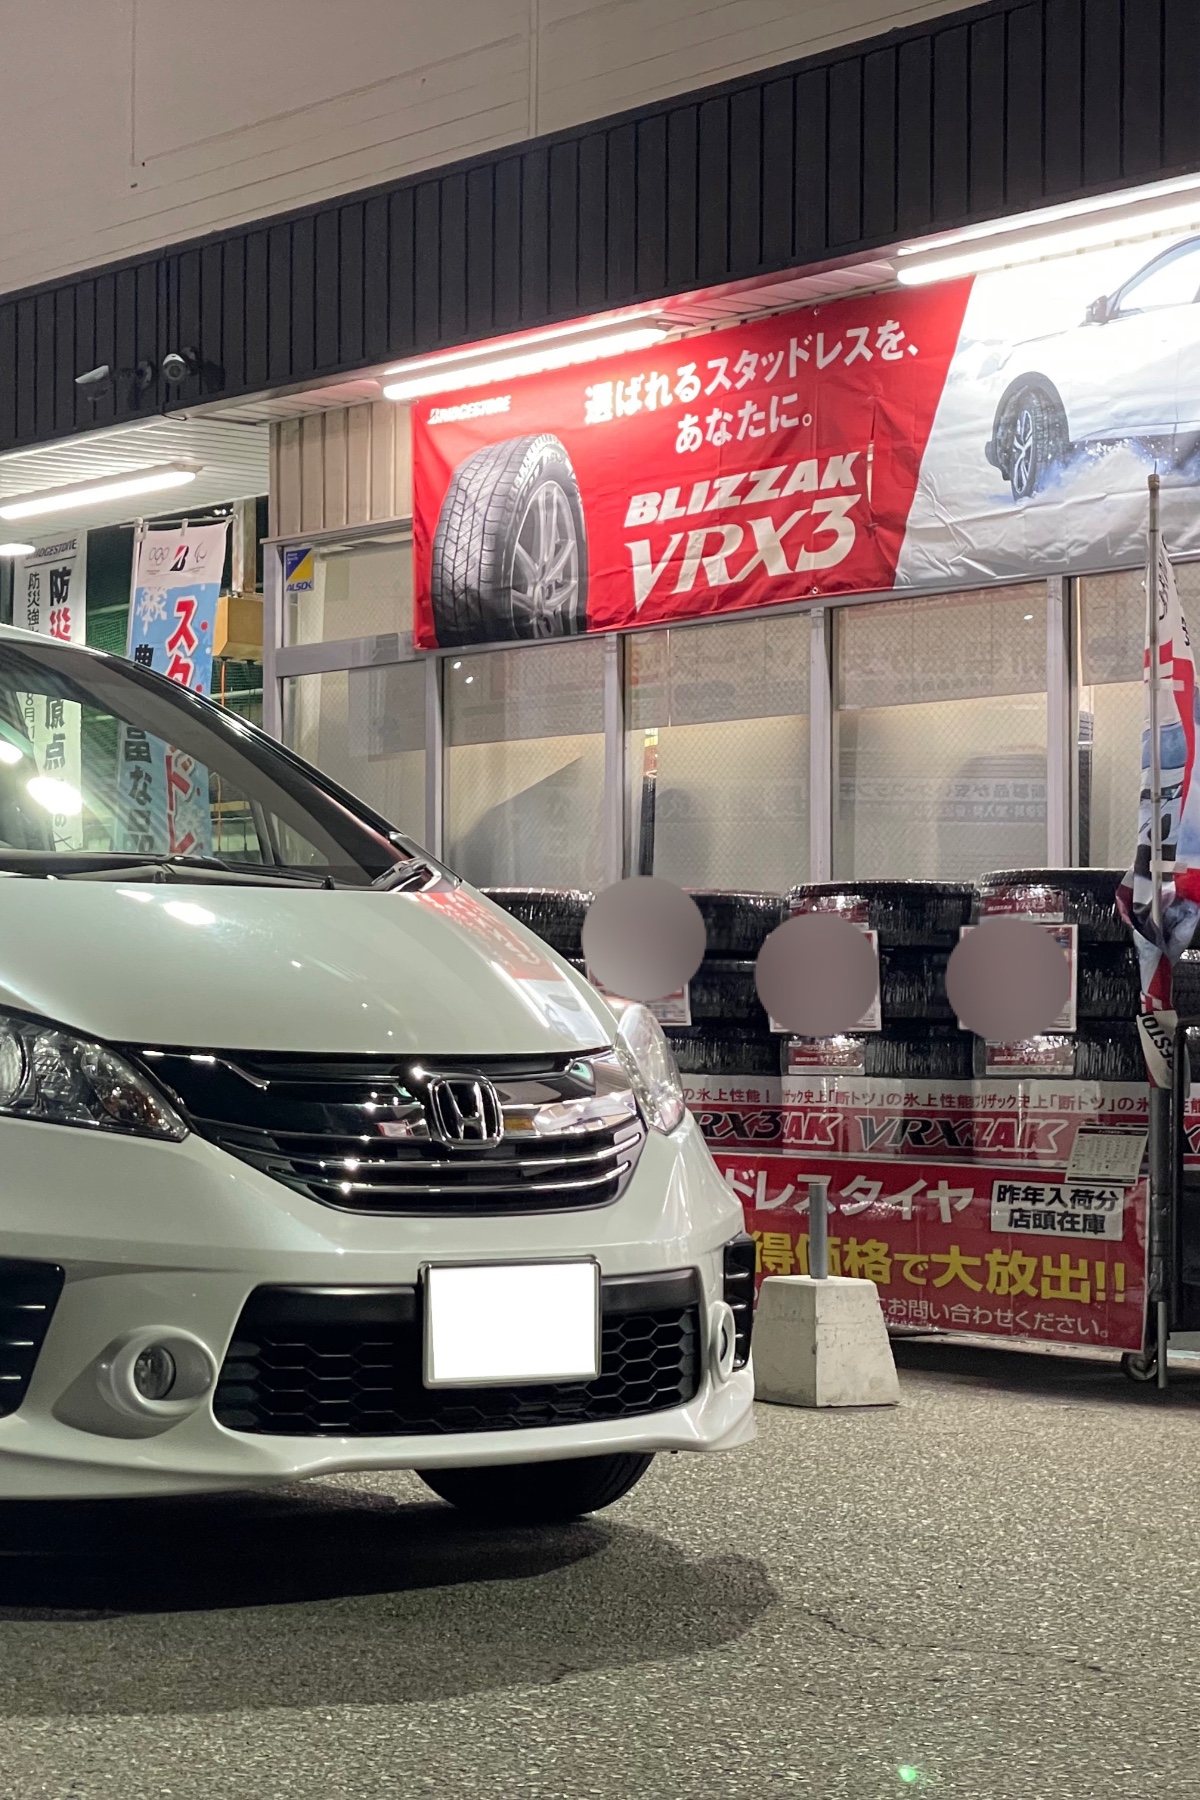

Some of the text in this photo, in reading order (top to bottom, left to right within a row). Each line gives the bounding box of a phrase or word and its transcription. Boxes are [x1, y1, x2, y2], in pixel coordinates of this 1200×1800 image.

[584, 319, 919, 425] 選ばれるスタッドレスを、
[675, 395, 813, 453] あなたに。
[623, 452, 861, 528] BLIZZAK
[624, 494, 862, 612] VRX3
[27, 571, 40, 633] 防災強
[287, 581, 312, 592] ALSOK
[693, 1110, 782, 1141] RX3
[722, 1167, 975, 1224] ドレスタイヤ
[996, 1184, 1120, 1212] 昨年入荷分
[1007, 1208, 1107, 1236] 店頭在庫
